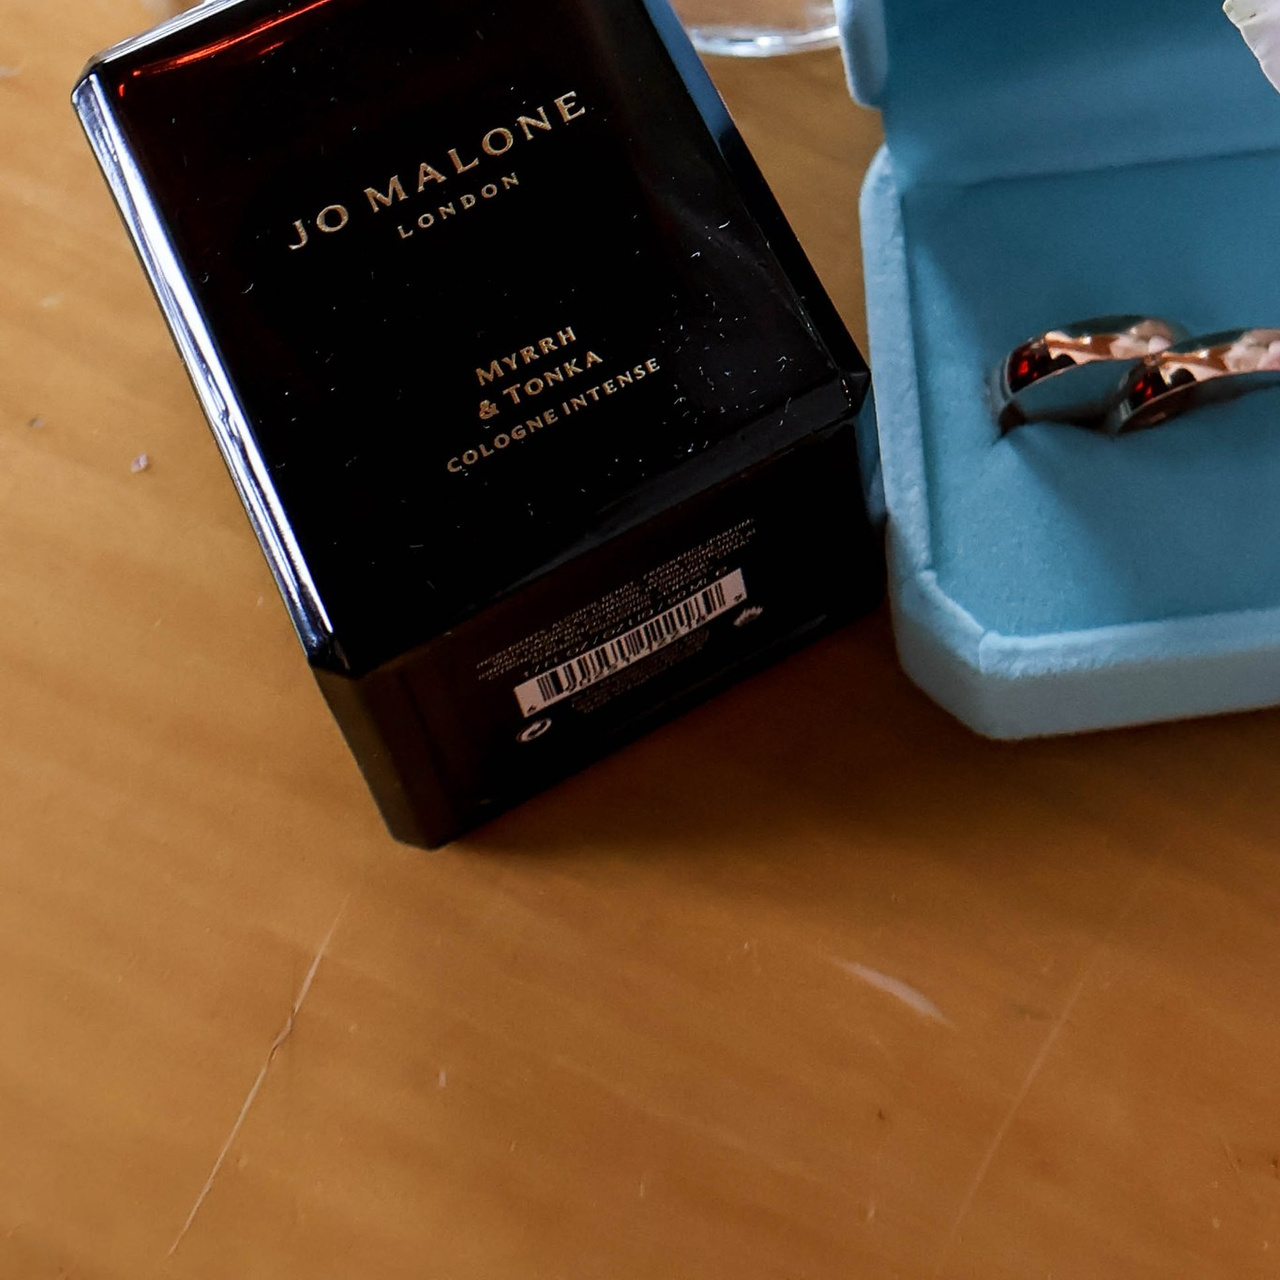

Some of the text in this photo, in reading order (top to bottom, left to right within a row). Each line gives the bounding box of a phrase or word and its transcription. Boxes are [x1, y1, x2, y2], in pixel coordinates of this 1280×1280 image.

[288, 91, 586, 251] JO MALONE
[397, 172, 520, 239] LONDON
[475, 326, 577, 387] MYRRH
[478, 350, 604, 420] & TONKA
[446, 357, 661, 473] COLOGNE INTENSE
